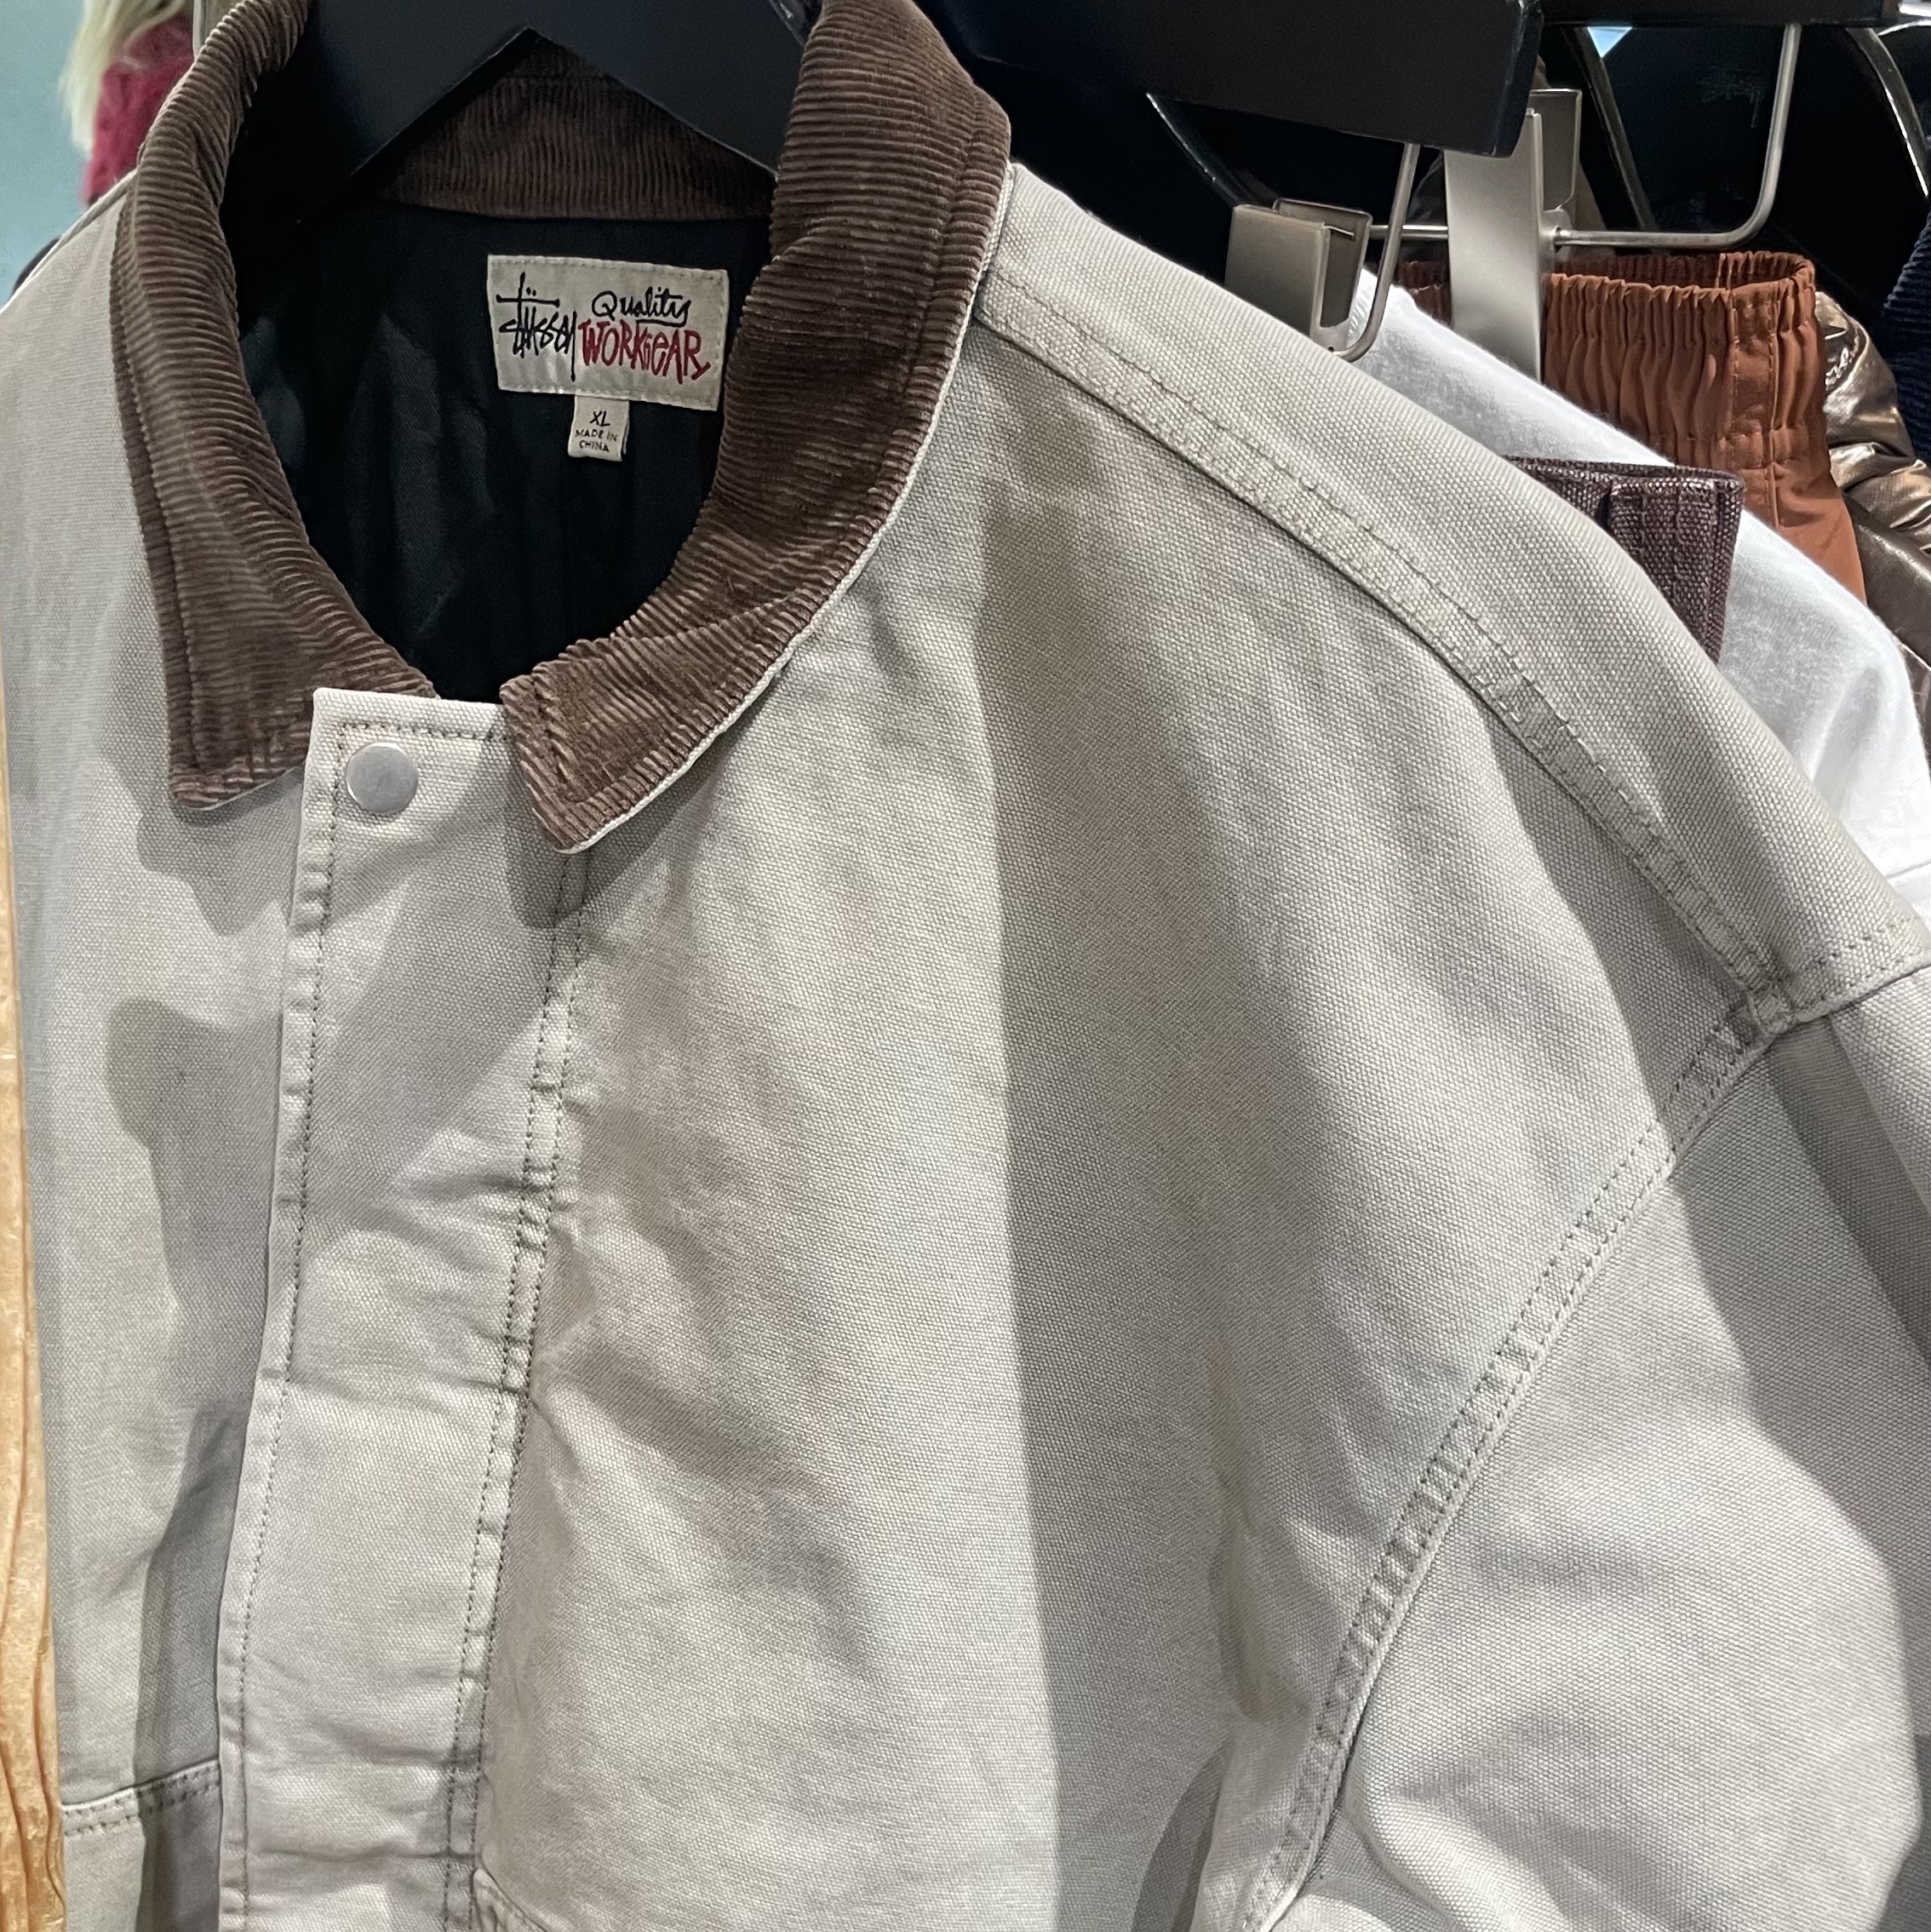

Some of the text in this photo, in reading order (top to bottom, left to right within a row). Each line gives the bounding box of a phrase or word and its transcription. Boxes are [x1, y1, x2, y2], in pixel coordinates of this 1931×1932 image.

[591, 286, 692, 328] Quality
[589, 410, 610, 427] XL
[575, 428, 618, 442] MADE IN
[579, 439, 610, 453] CHINA
